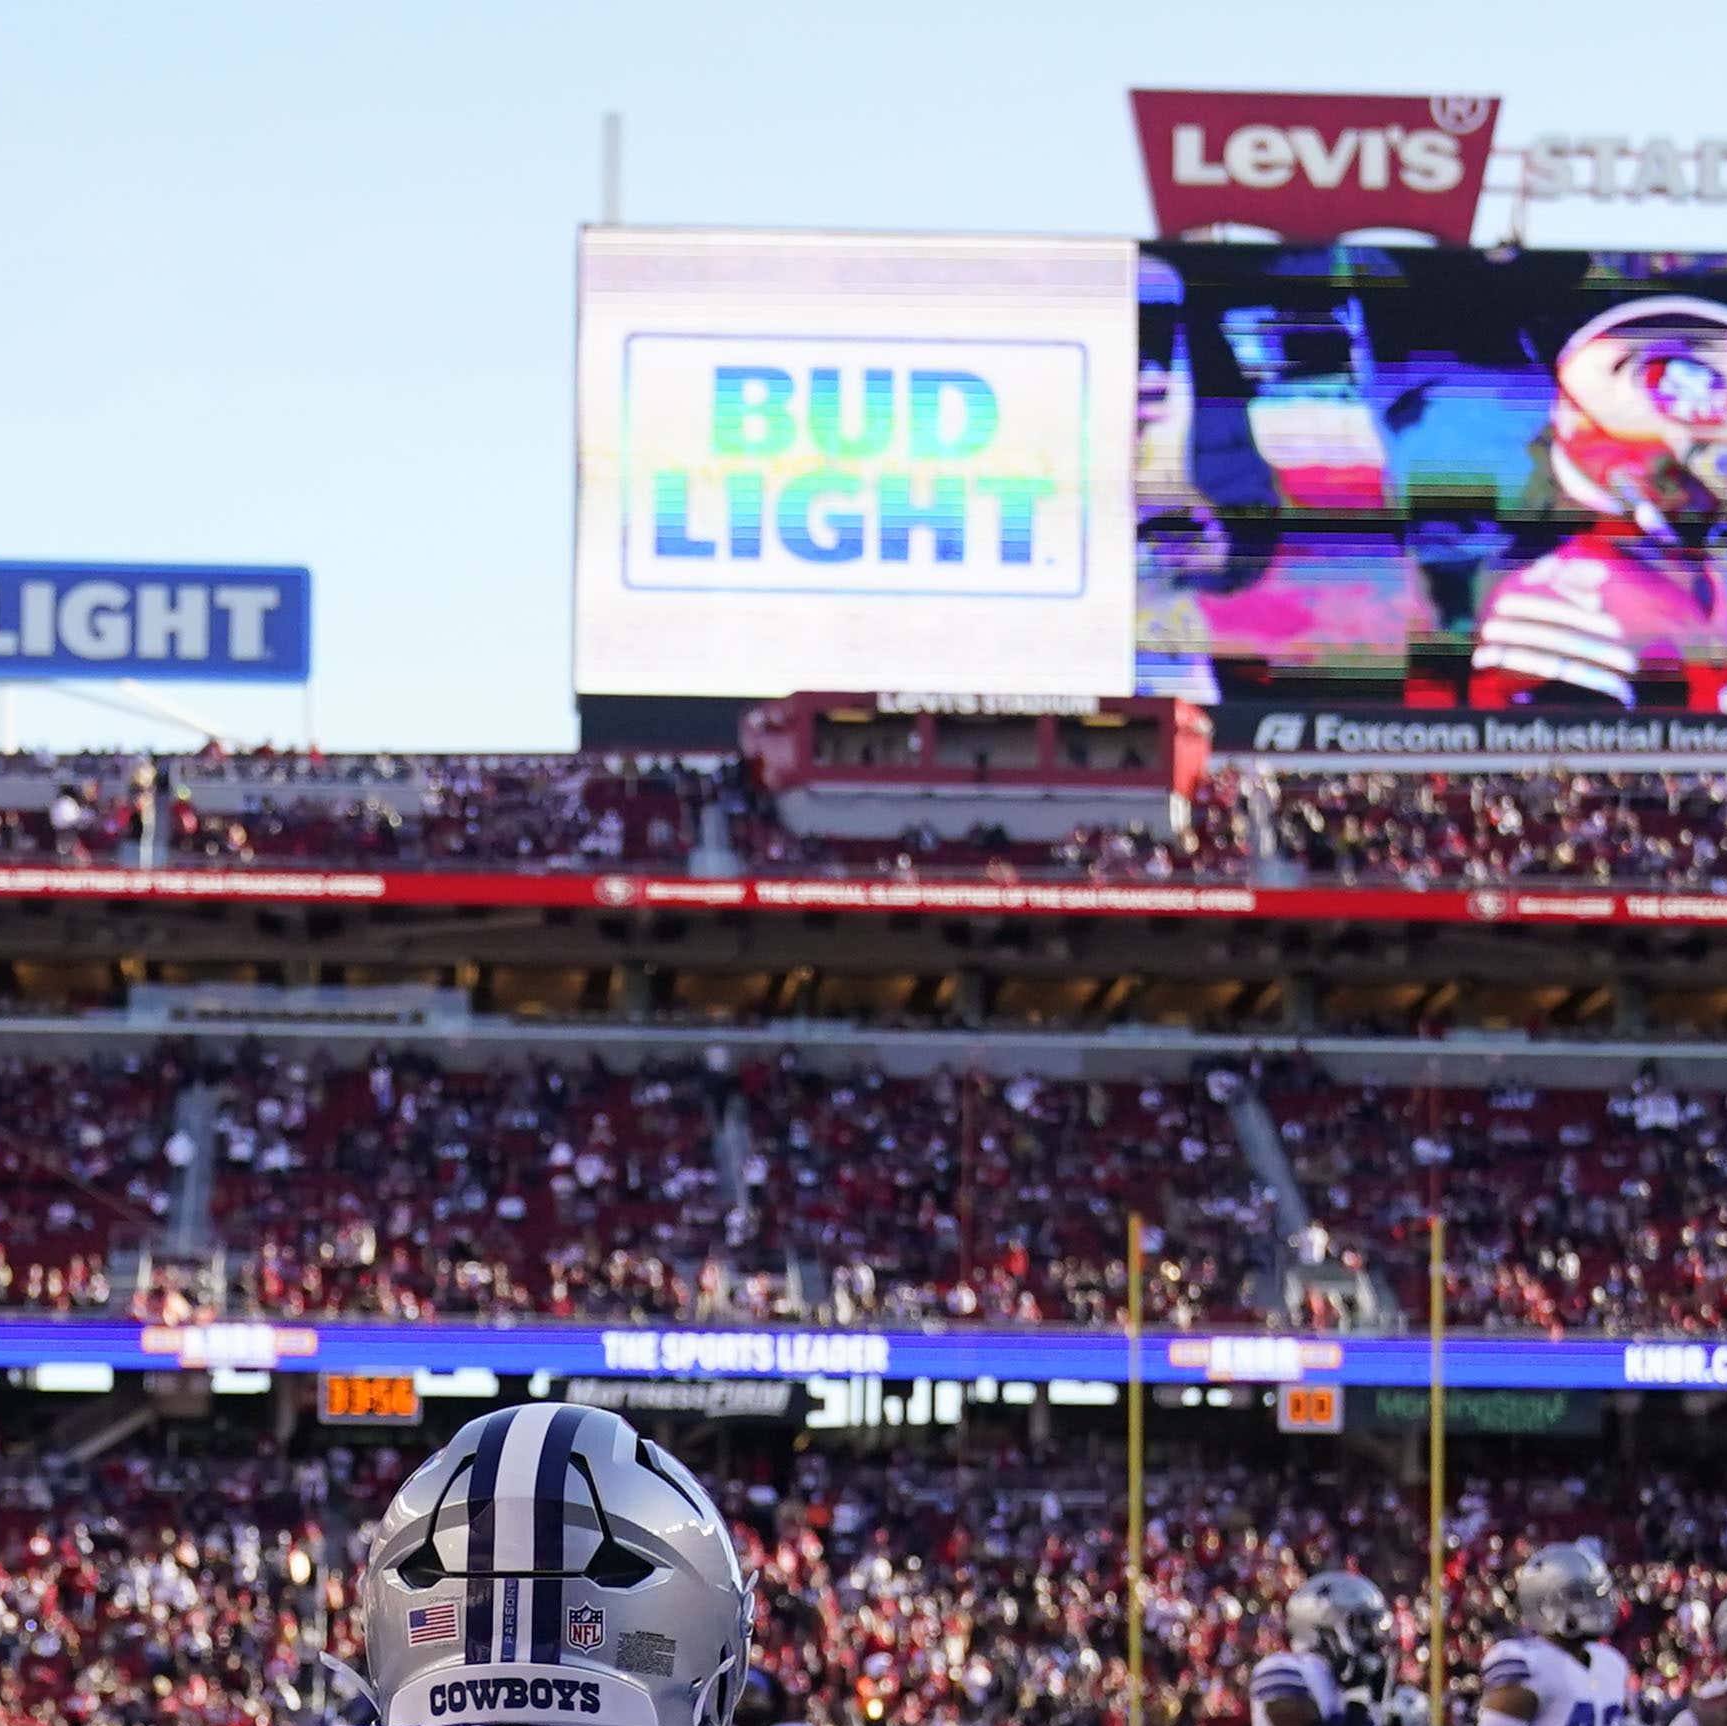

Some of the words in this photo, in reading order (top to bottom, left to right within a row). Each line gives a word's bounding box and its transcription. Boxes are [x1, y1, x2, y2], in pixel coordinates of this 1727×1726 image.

[711, 366, 999, 459] BUD
[651, 470, 1056, 566] LIGHT
[1315, 713, 1479, 752] Foxconn
[1484, 716, 1662, 752] Industrial
[572, 1625, 600, 1645] NFL
[429, 1677, 601, 1716] COWBOYS
